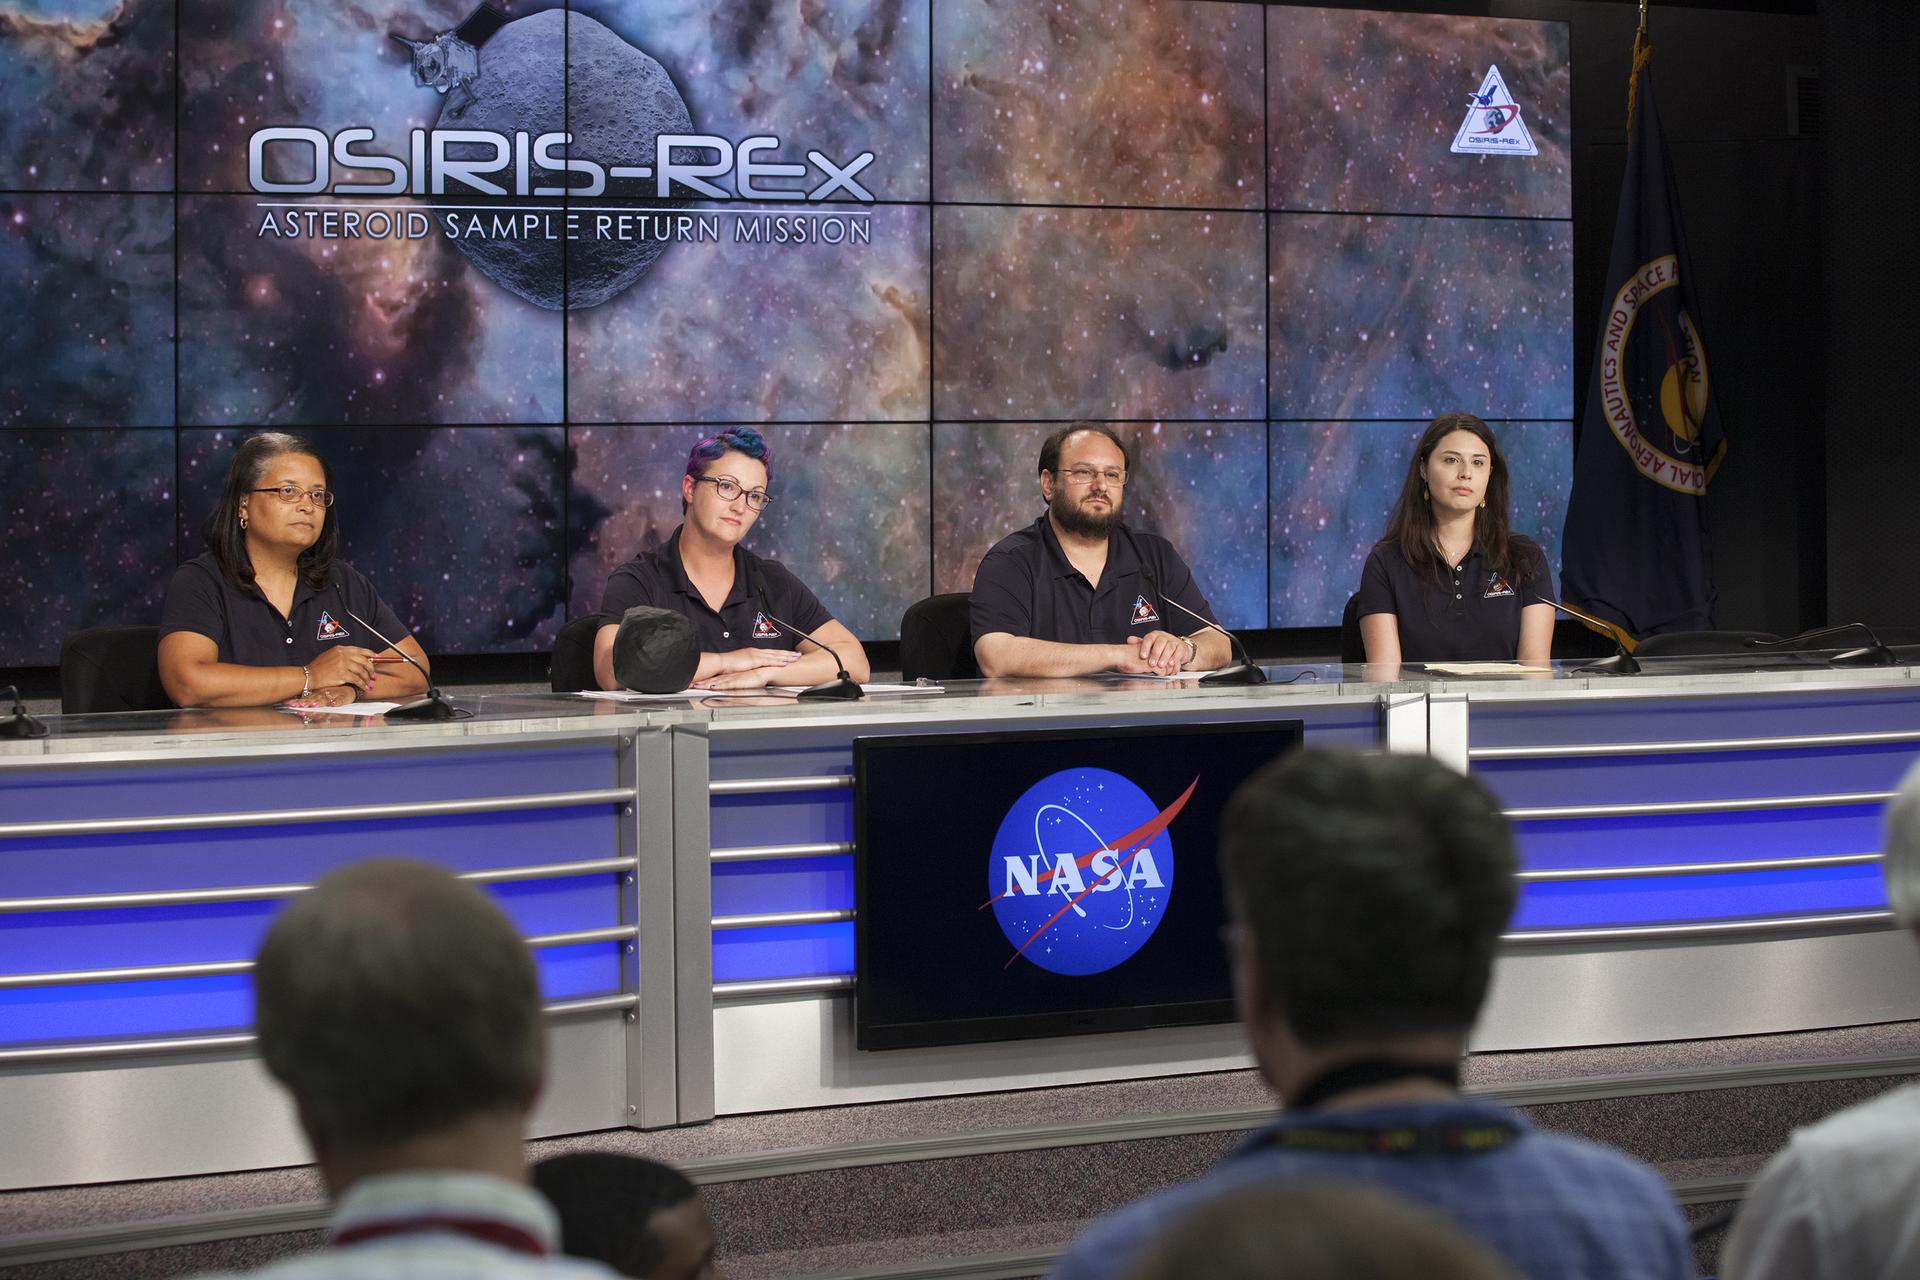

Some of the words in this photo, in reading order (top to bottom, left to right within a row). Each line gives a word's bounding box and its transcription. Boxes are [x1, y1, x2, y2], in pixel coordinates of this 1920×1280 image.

[258, 211, 429, 239] ASTEROID
[446, 212, 579, 241] SAMPLE
[596, 215, 718, 242] RETURN
[735, 217, 871, 245] MISSION
[1623, 265, 1666, 309] SPACE
[1607, 310, 1628, 351] AND
[1604, 358, 1666, 474] AERONAUTICS
[1003, 848, 1165, 897] NASA
